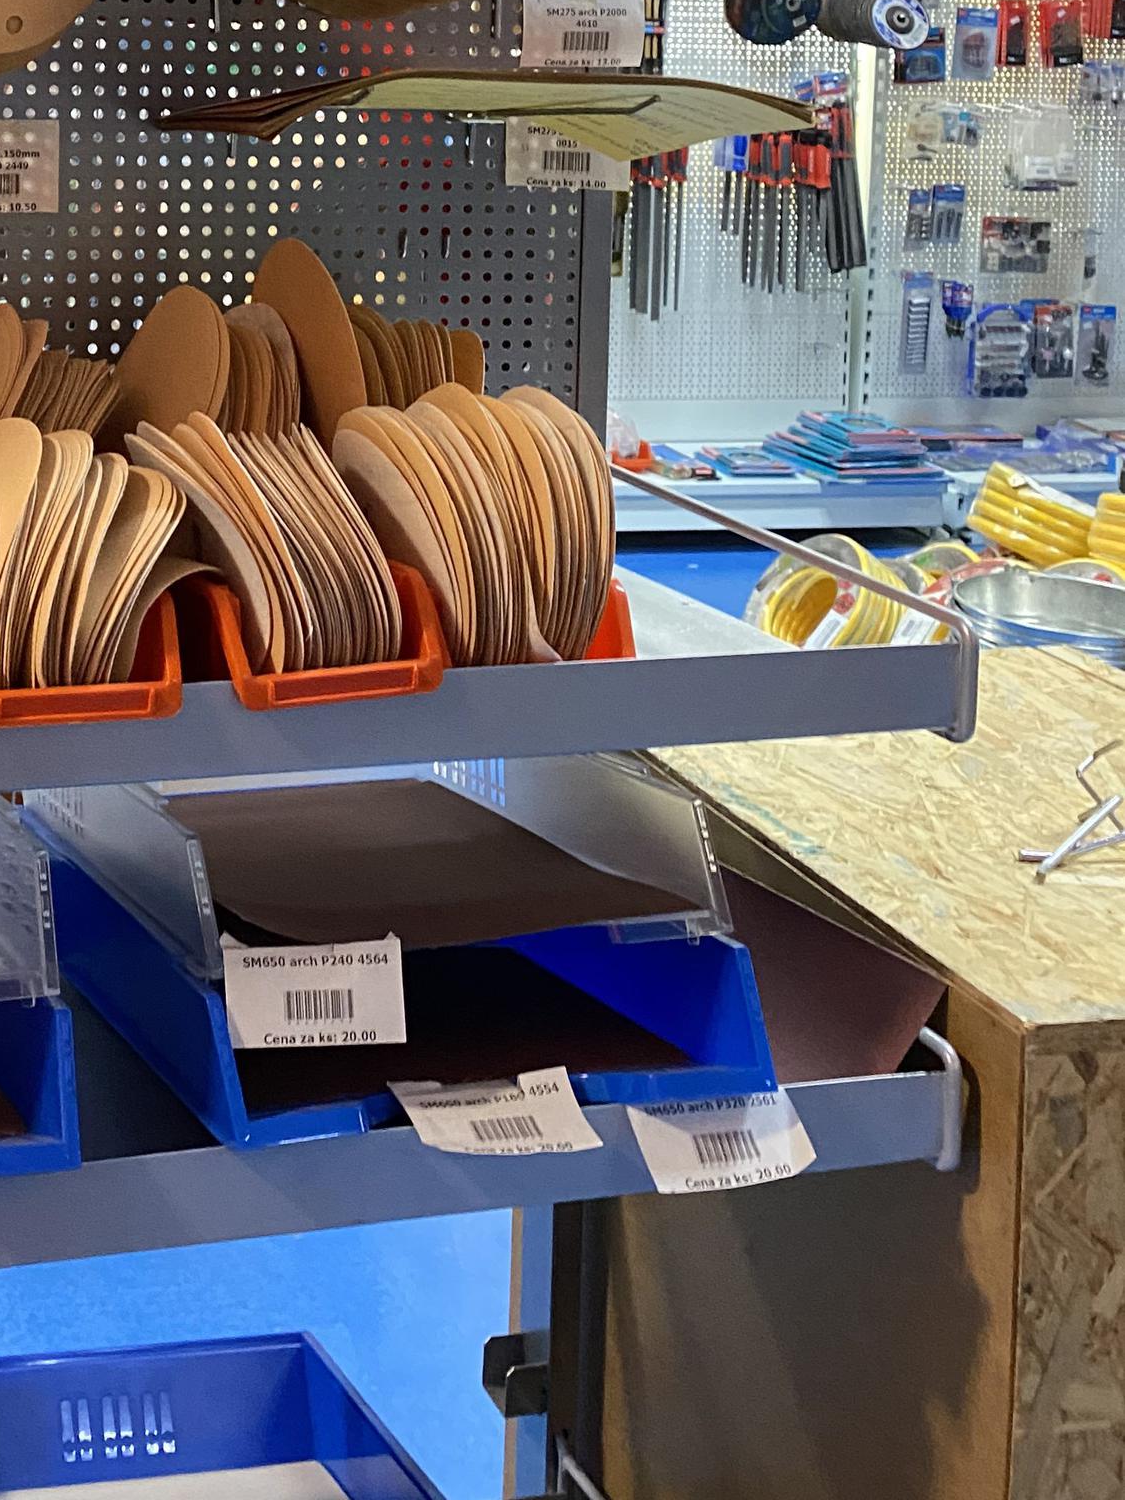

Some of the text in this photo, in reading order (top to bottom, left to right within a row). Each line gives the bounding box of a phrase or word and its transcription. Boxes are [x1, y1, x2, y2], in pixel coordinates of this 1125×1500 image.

[547, 8, 627, 17] SM275 arch P2000
[544, 58, 567, 66] Cena
[5, 162, 29, 171] 2449
[527, 177, 549, 186] Cena
[580, 179, 606, 188] 14.00
[10, 203, 37, 211] 10.50
[243, 953, 388, 968] SM650 arch P240 4564
[264, 1030, 377, 1045] Cena za ks: 20.00
[529, 1082, 560, 1096] 4554
[688, 1102, 714, 1114] arch
[686, 1164, 792, 1189] Cena za ks: 20.00
